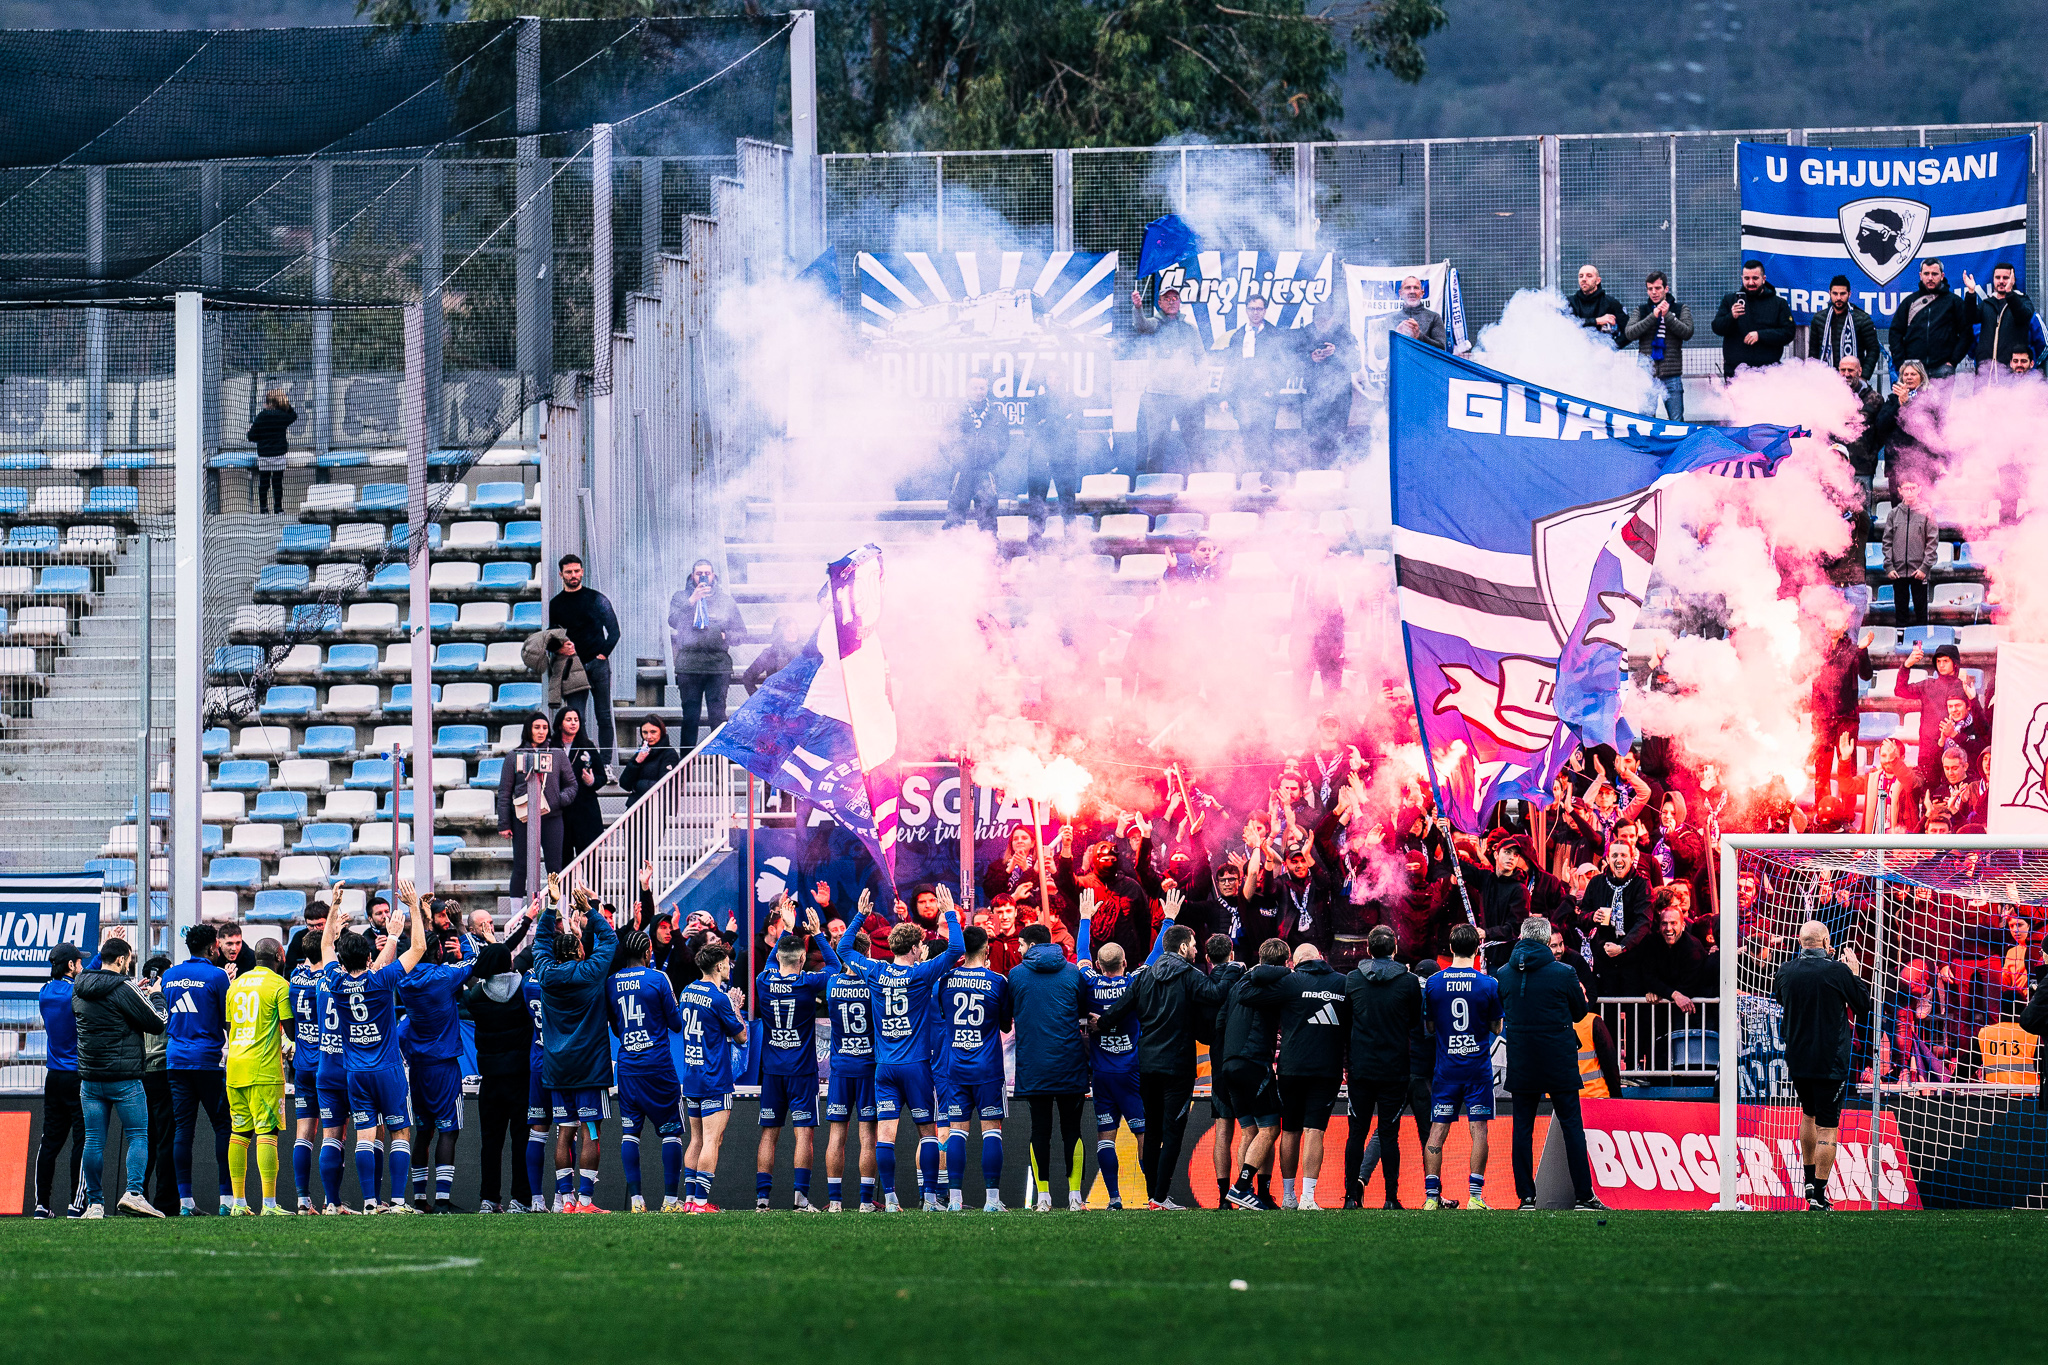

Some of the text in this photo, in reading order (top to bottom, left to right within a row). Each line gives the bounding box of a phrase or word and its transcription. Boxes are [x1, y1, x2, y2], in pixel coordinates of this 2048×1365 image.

[1766, 151, 1999, 188] U GHJUNSANI
[1775, 287, 1831, 314] ERR
[617, 979, 641, 992] ETOGA
[769, 982, 793, 993] ARISS
[831, 987, 870, 999] DUCROCQ
[947, 978, 992, 991] RODRIGUES
[1446, 981, 1472, 992] F.TOMI
[233, 991, 260, 1024] 30
[296, 989, 312, 1021] 4
[325, 997, 340, 1031] 5
[349, 993, 369, 1022] 6
[617, 994, 646, 1029] 14
[770, 998, 796, 1030] 17
[882, 987, 909, 1016] 15
[953, 992, 985, 1027] 25
[1451, 997, 1470, 1032] 9
[682, 1007, 704, 1043] 24
[837, 1002, 868, 1034] 13
[1990, 1040, 2020, 1056] 013
[1584, 1128, 1910, 1204] BURGR KNG
